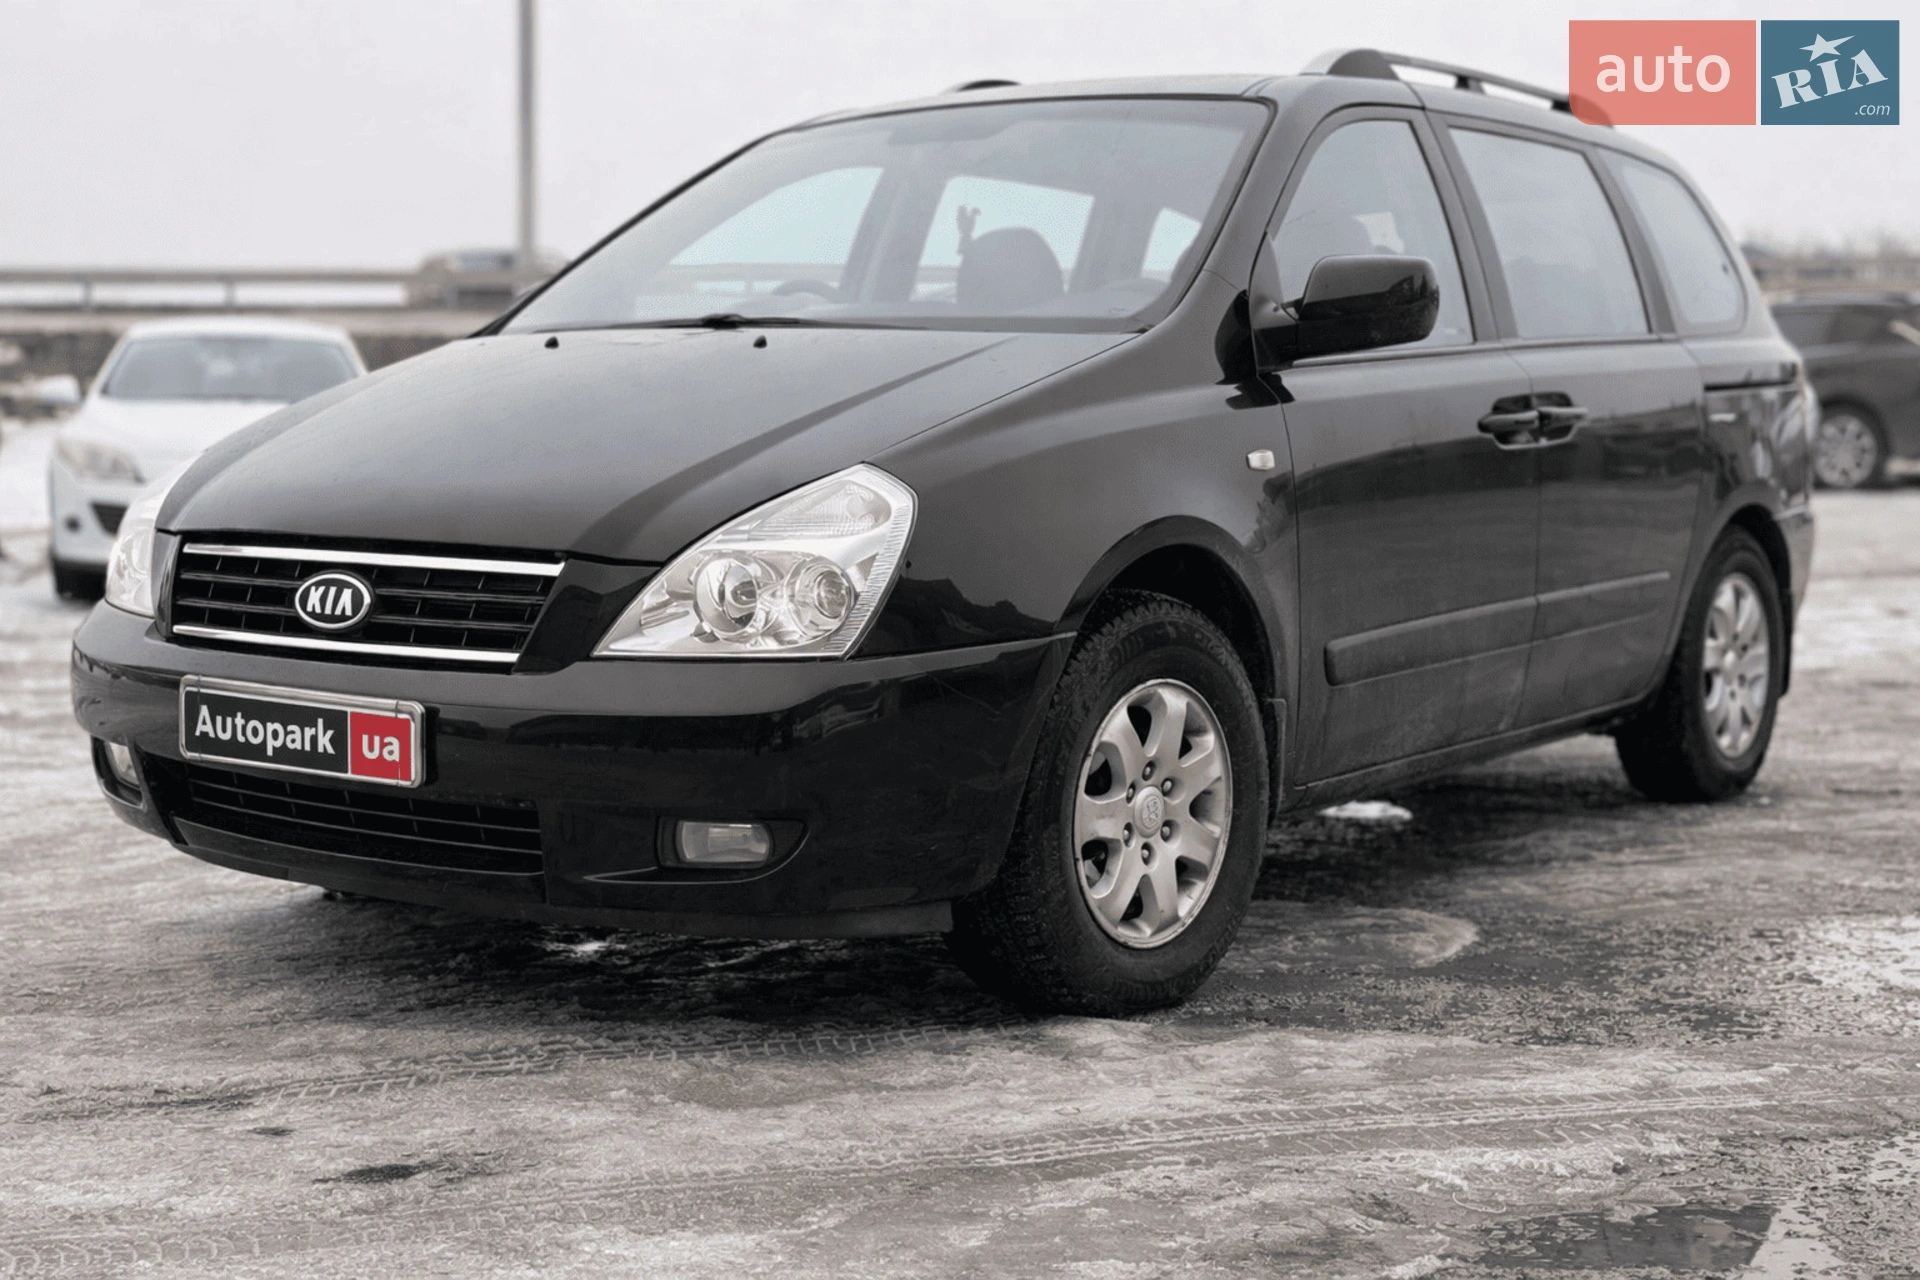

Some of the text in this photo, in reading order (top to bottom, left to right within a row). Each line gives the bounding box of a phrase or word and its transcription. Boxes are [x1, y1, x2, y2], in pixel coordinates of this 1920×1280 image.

[306, 585, 353, 616] KIA
[195, 704, 401, 762] Autopark ua
